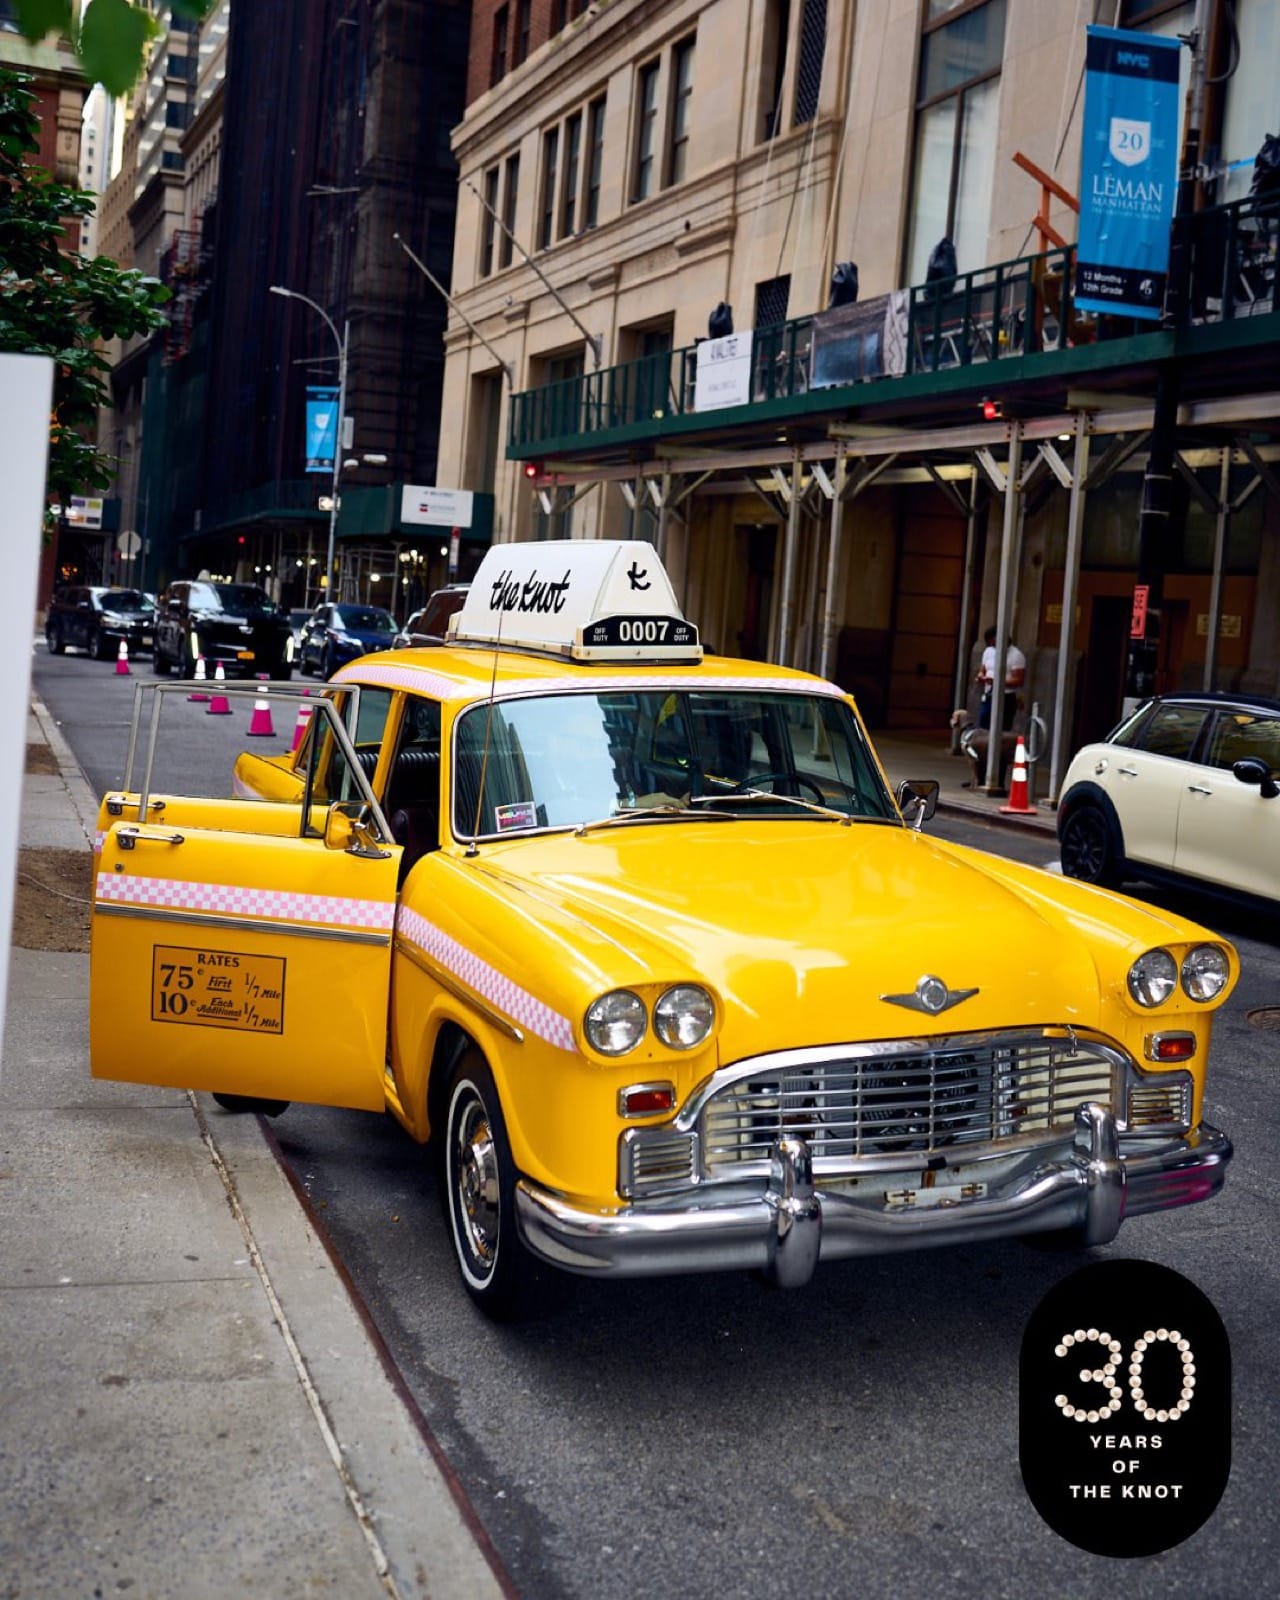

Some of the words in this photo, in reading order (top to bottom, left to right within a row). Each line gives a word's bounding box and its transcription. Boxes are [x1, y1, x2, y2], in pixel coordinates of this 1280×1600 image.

[1117, 51, 1150, 68] NYC
[1117, 130, 1143, 151] 20
[1091, 197, 1162, 214] MANHATTAN
[1093, 272, 1122, 284] Months
[1100, 284, 1123, 296] Grade
[489, 569, 520, 612] the
[518, 569, 572, 614] knot
[593, 634, 609, 642] DUTY
[594, 627, 606, 635] OFF
[619, 620, 669, 642] 0007
[673, 634, 690, 642] DUTY
[197, 953, 240, 968] RATES
[207, 976, 233, 989] First
[244, 973, 260, 999] 1/7
[261, 988, 281, 1000] Mile
[210, 997, 234, 1009] Each
[196, 1004, 243, 1018] Additional
[243, 1002, 259, 1027] 1/7
[259, 1018, 280, 1029] Mile
